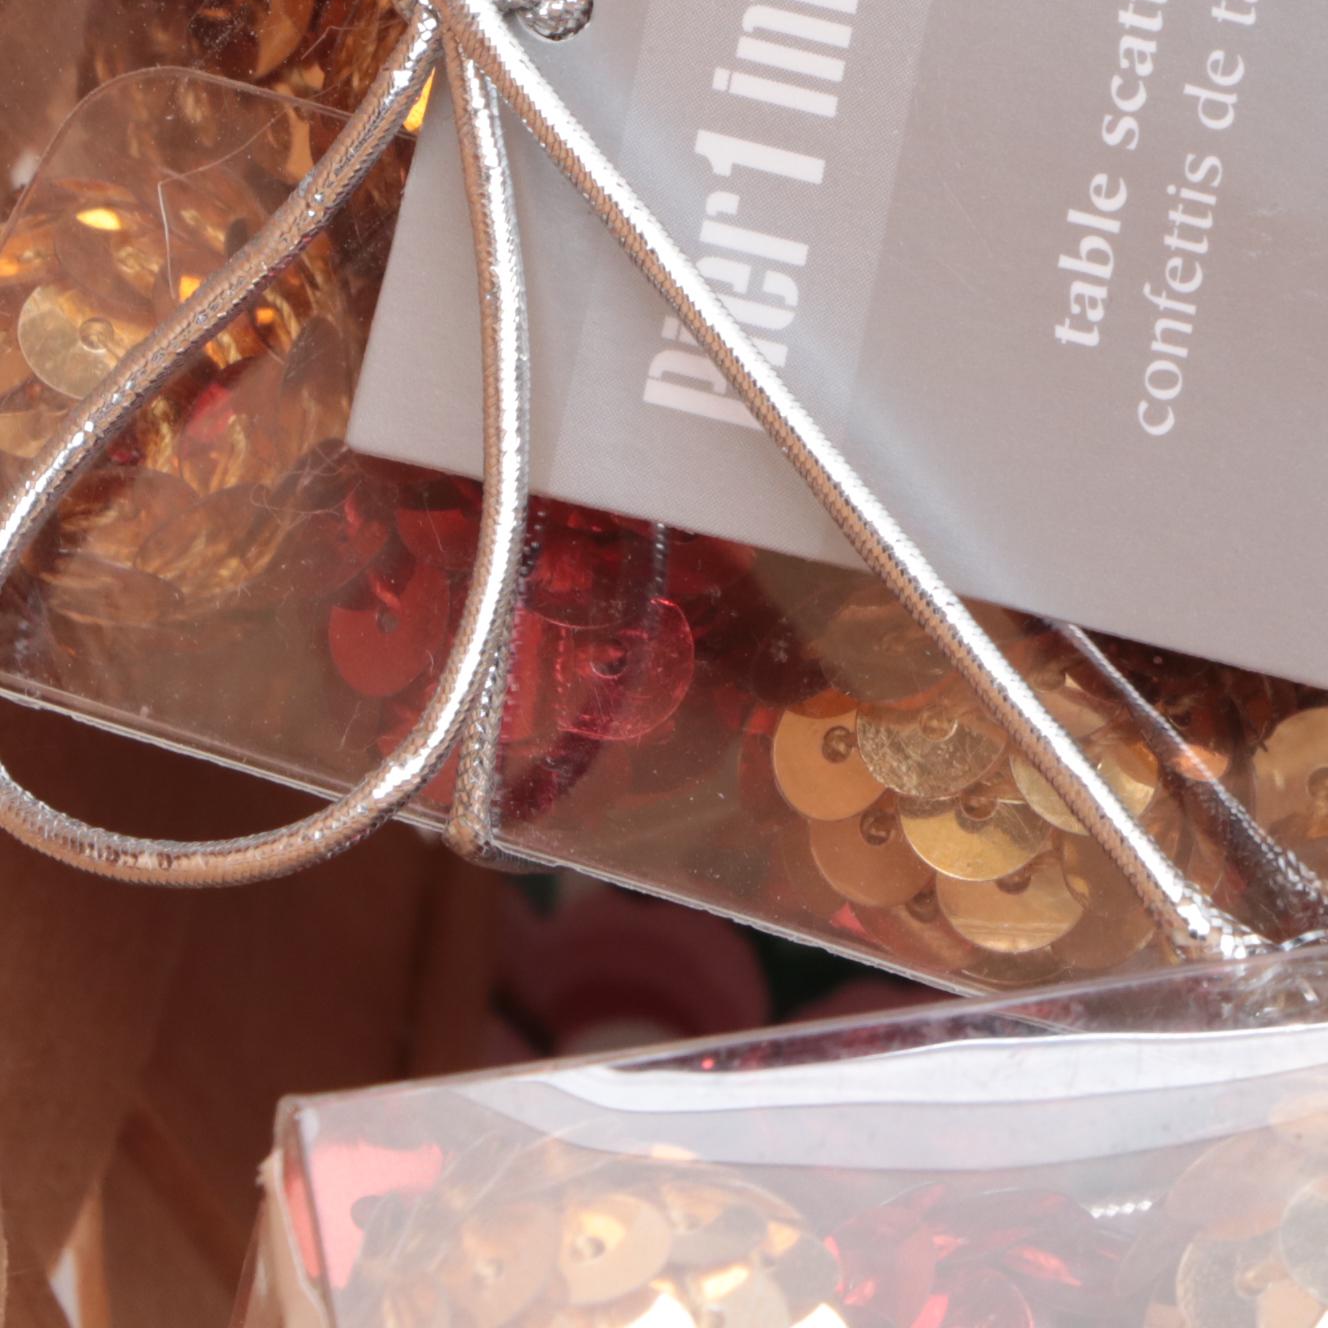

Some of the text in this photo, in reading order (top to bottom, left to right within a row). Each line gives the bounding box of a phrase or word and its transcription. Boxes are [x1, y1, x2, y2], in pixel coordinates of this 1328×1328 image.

[695, 129, 826, 184] 1
[1137, 153, 1223, 436] confettis
[1183, 50, 1246, 130] de
[1055, 173, 1127, 348] table
